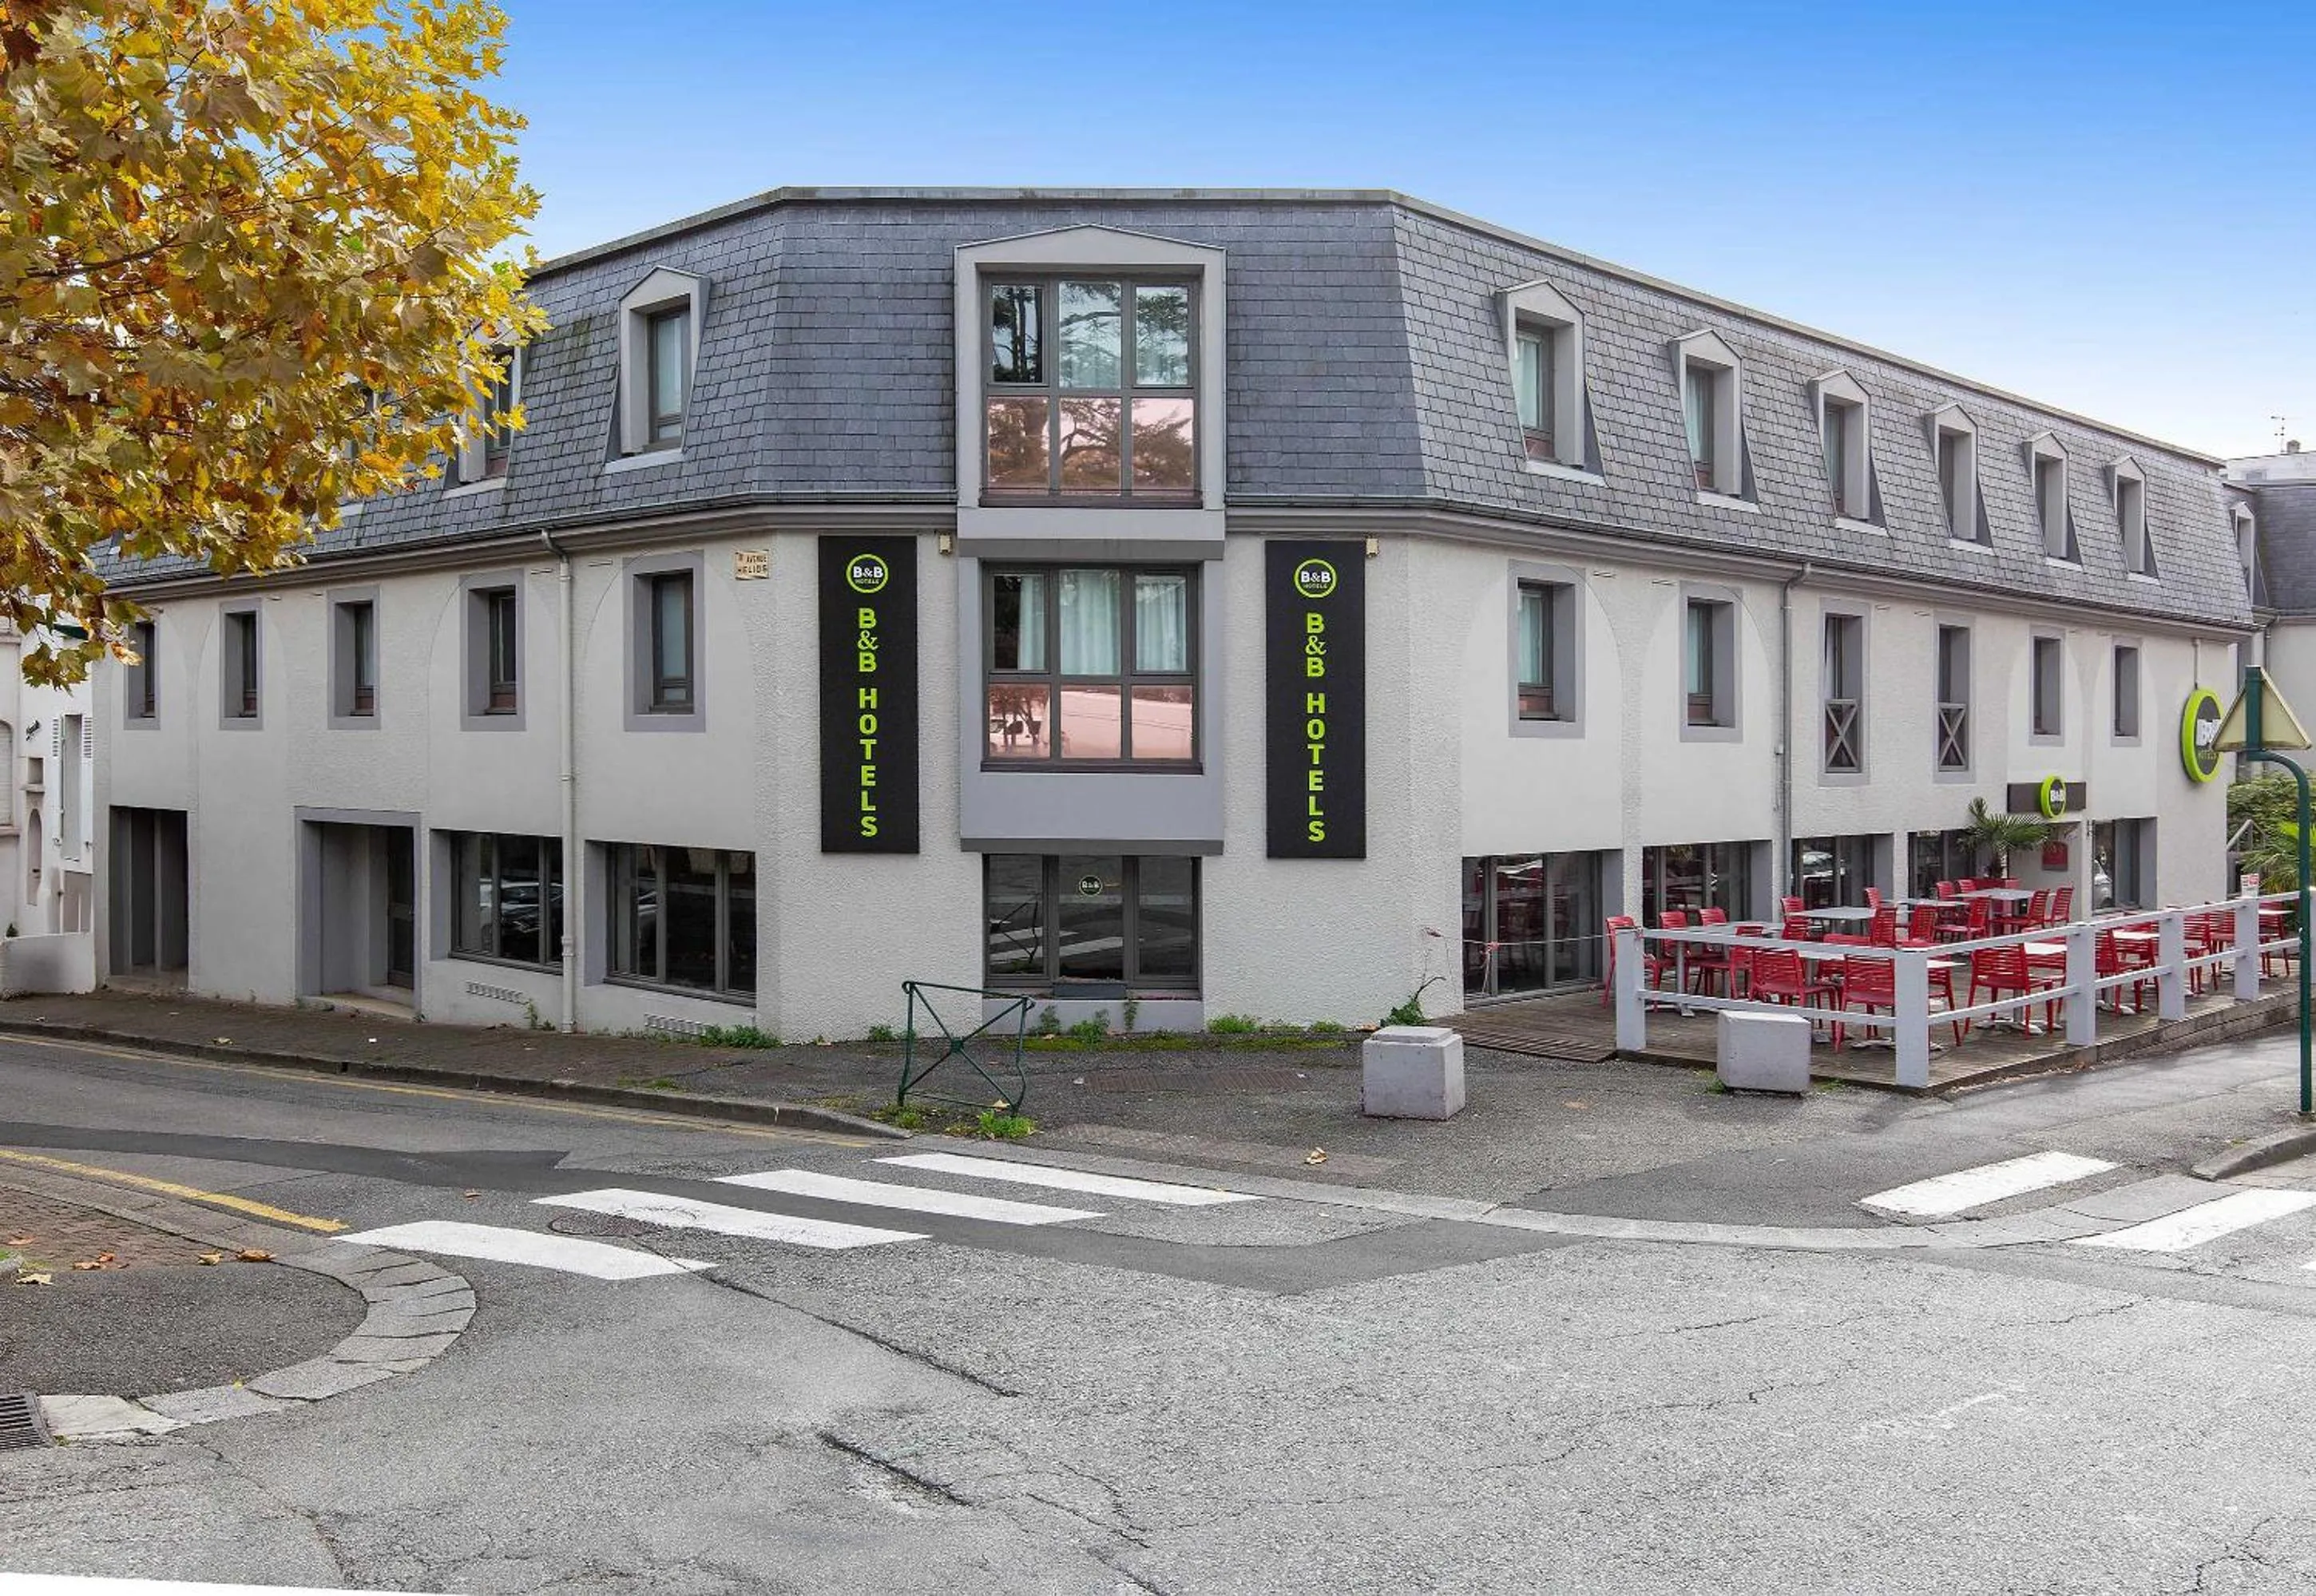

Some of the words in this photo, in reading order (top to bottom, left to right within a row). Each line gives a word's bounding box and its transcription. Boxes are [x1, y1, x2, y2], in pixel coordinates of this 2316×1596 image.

[853, 566, 883, 578] B&B
[1301, 571, 1331, 583] B&B
[858, 608, 878, 671] B&B
[1305, 612, 1327, 677] B&B
[859, 688, 877, 837] HOTELS
[1307, 693, 1325, 842] HOTELS
